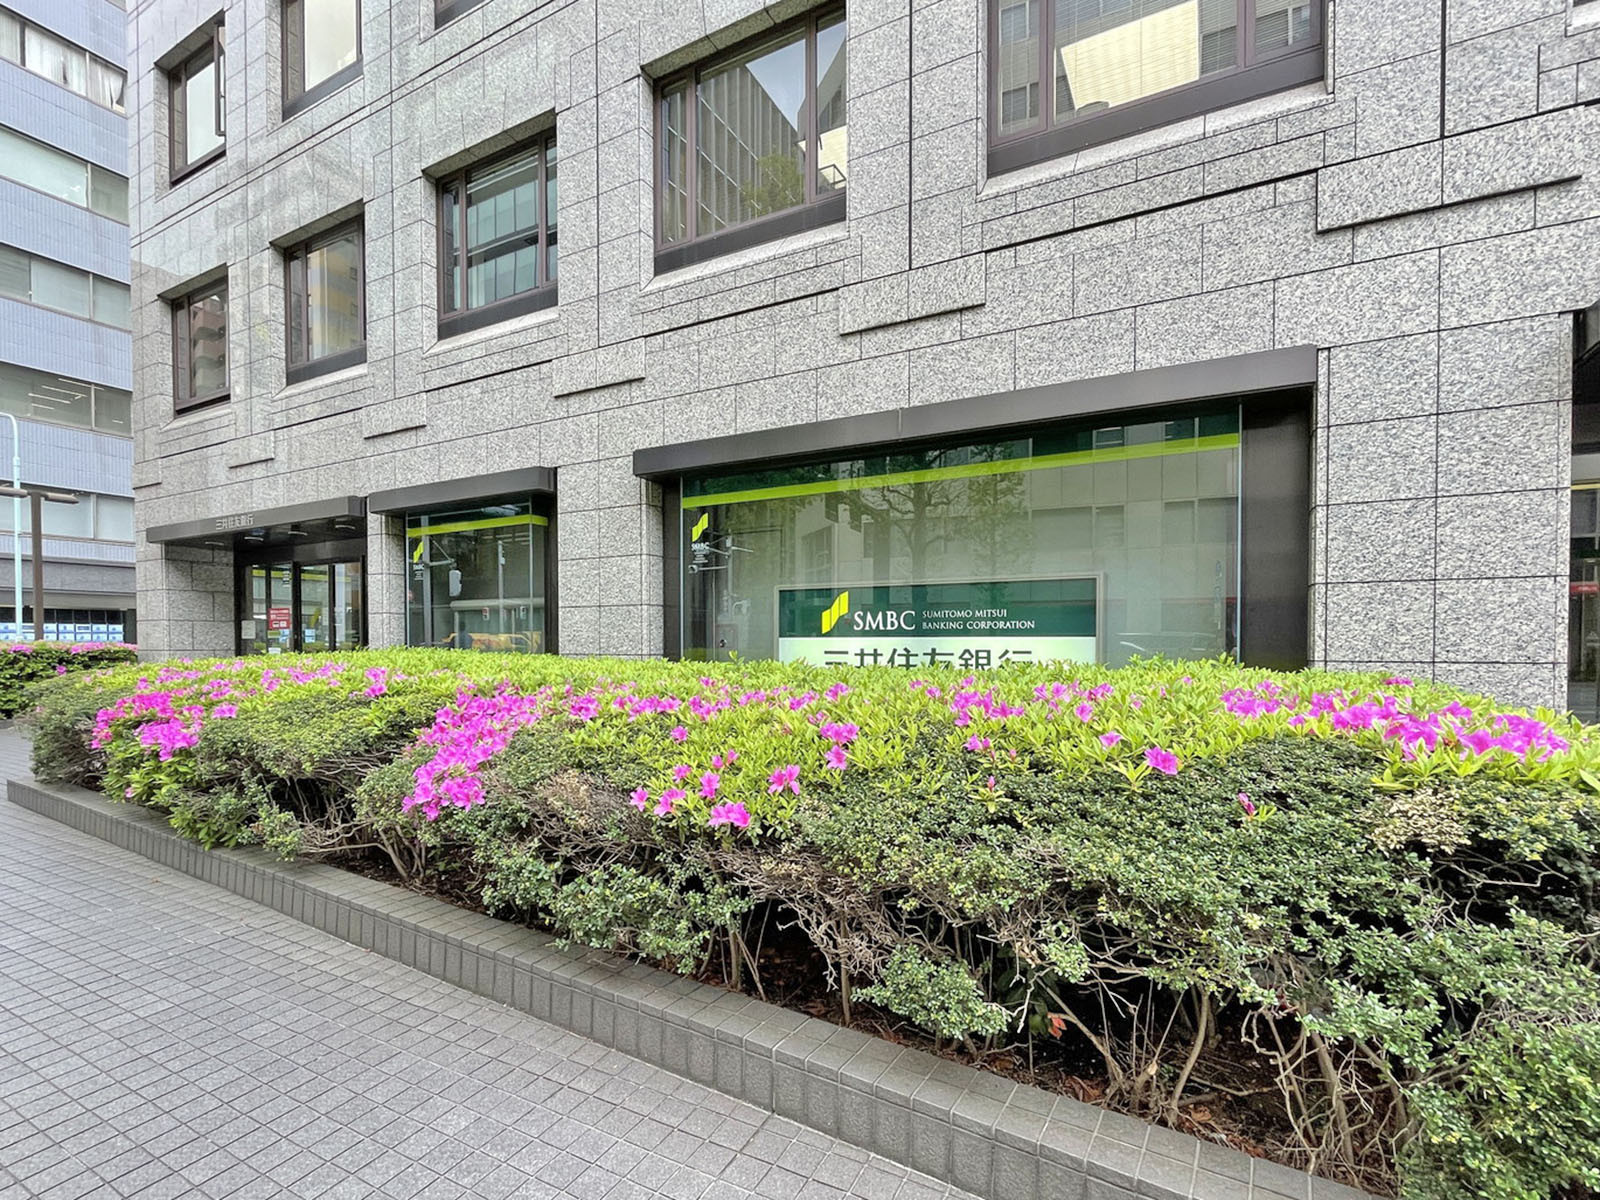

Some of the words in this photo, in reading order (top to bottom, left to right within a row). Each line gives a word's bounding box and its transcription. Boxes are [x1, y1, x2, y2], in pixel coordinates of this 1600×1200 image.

[922, 610, 973, 619] SUMITOMO
[974, 609, 1007, 618] MITSUI
[853, 610, 916, 631] SMBC
[922, 621, 963, 630] BANKING
[966, 620, 1035, 629] CORPORATION
